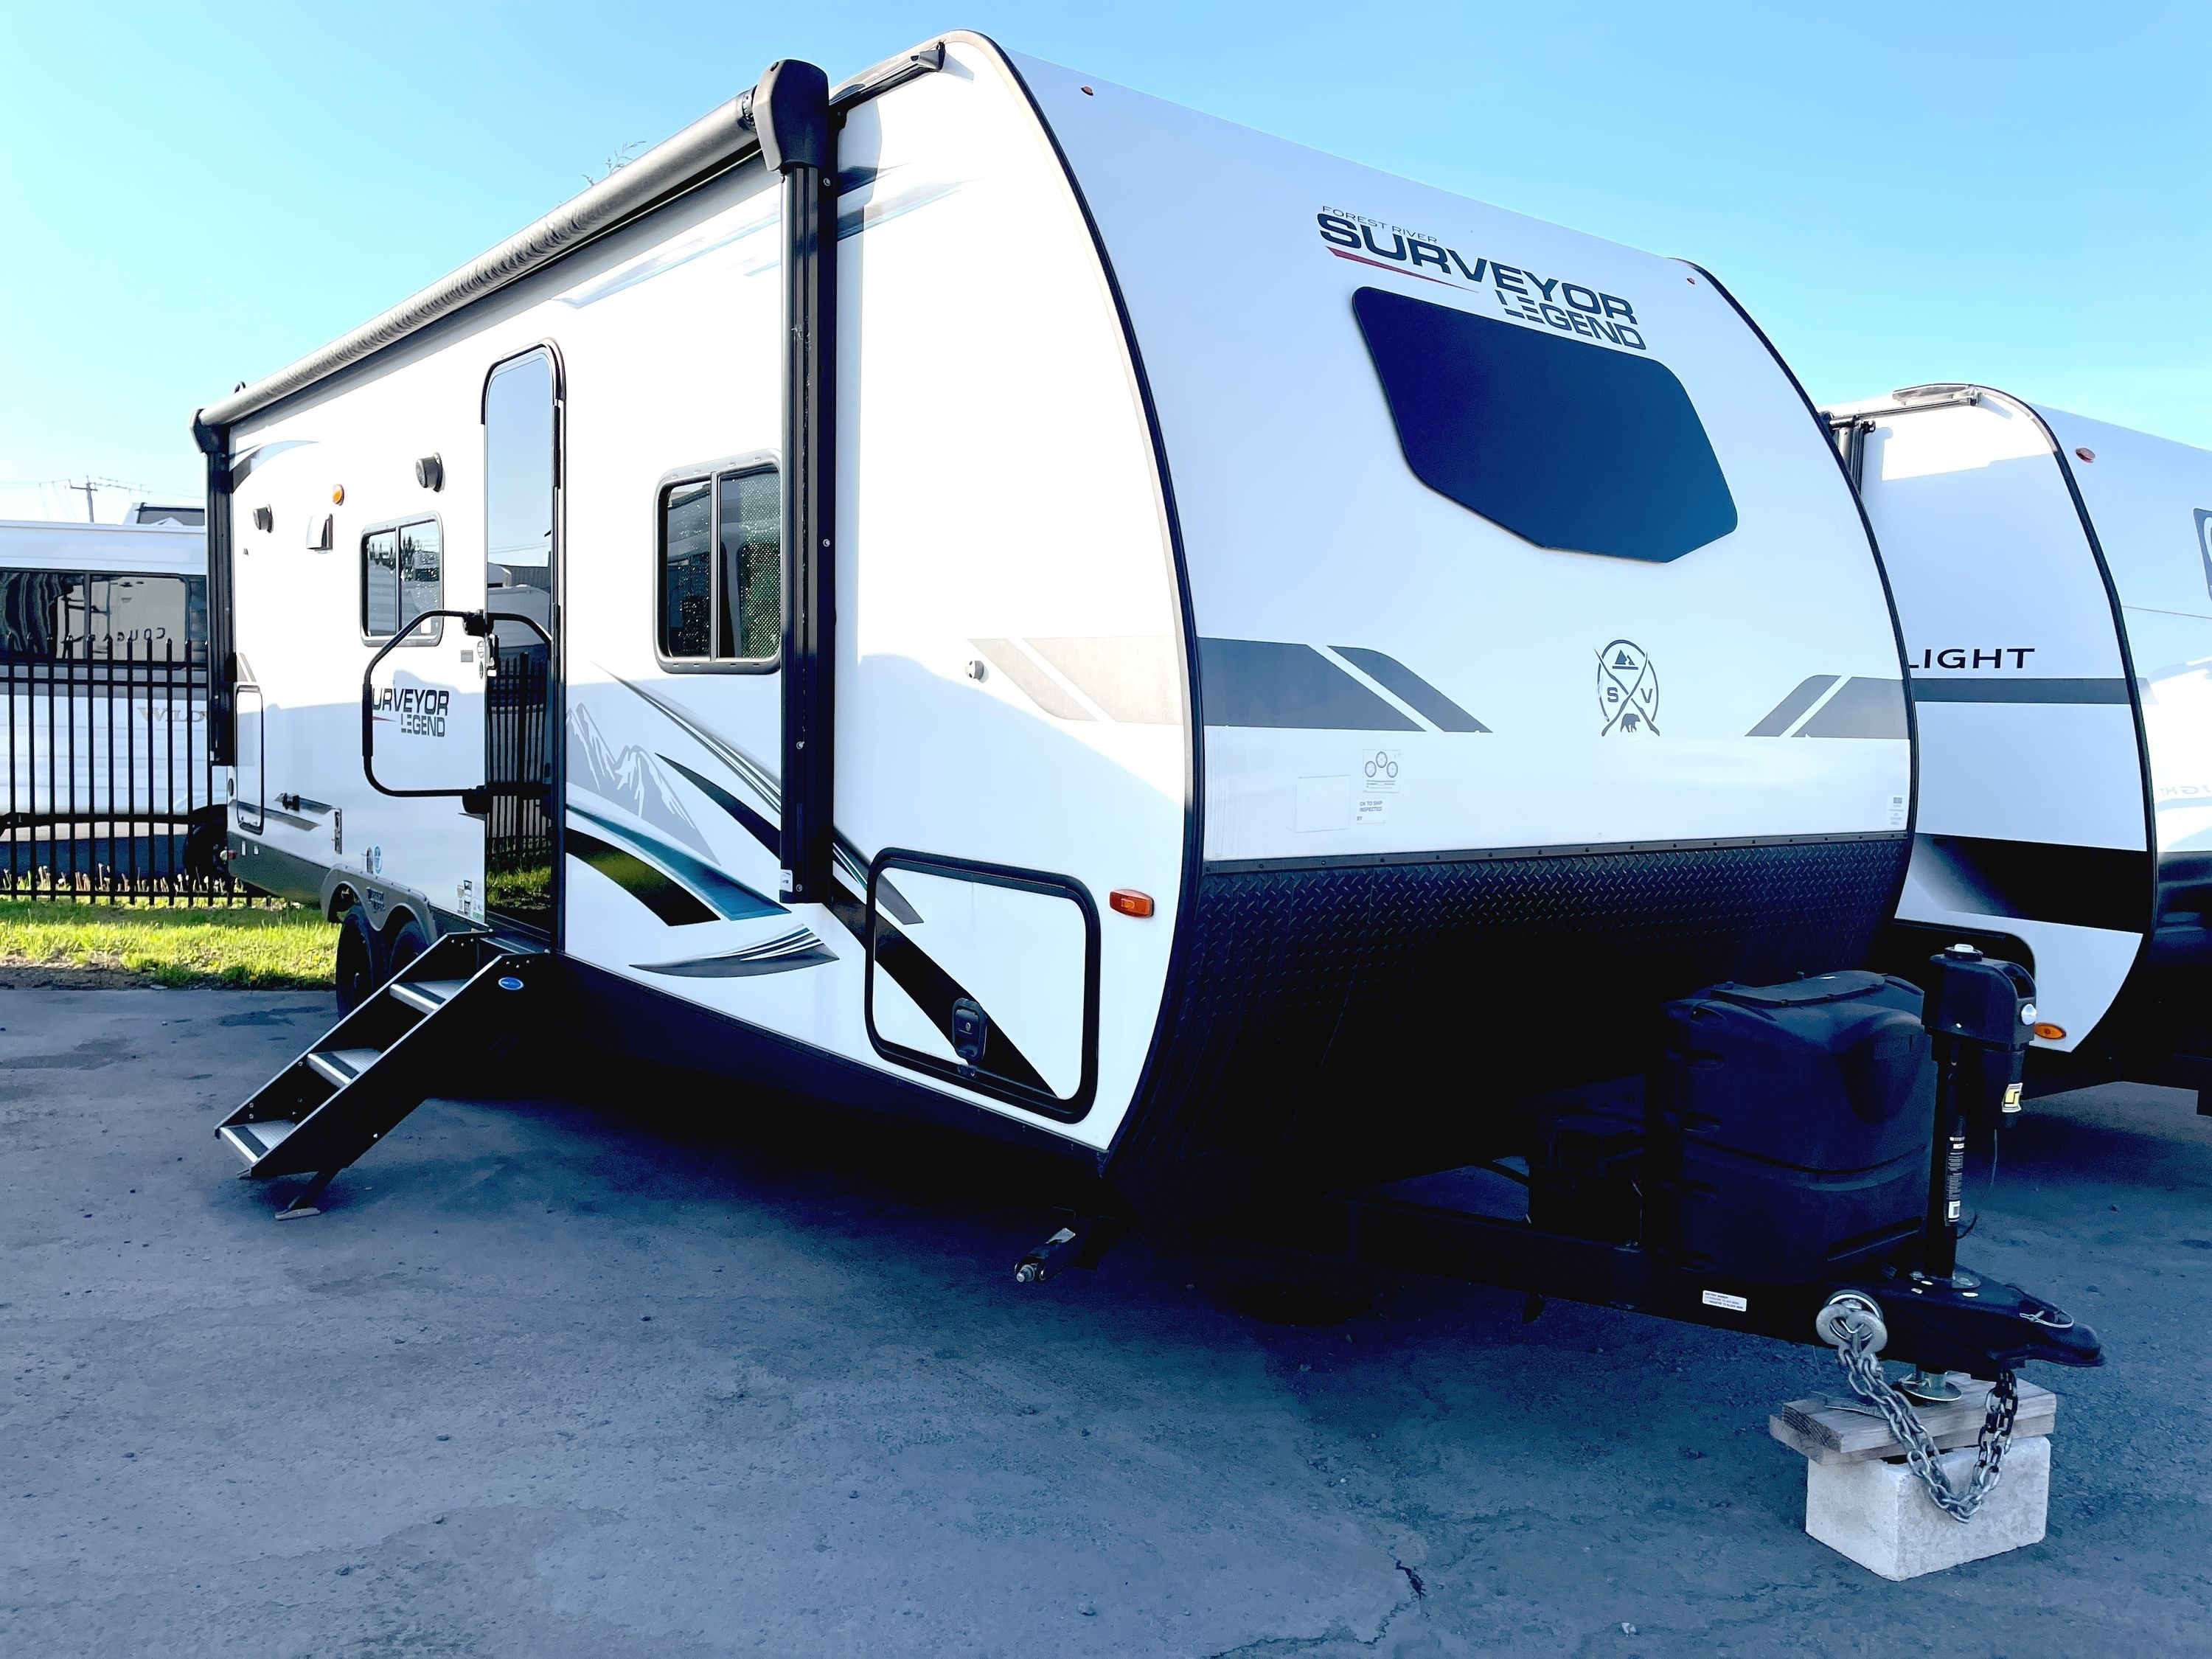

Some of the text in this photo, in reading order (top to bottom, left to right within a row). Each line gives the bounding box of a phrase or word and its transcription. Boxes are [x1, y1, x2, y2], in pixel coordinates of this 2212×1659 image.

[1322, 206, 1437, 244] FOREST RIVER
[1317, 213, 1638, 325] SURVEYOR
[1495, 289, 1646, 350] LEGEND
[372, 688, 449, 716] URVEYOR
[1607, 687, 1652, 703] S V
[401, 713, 445, 737] LEGEND
